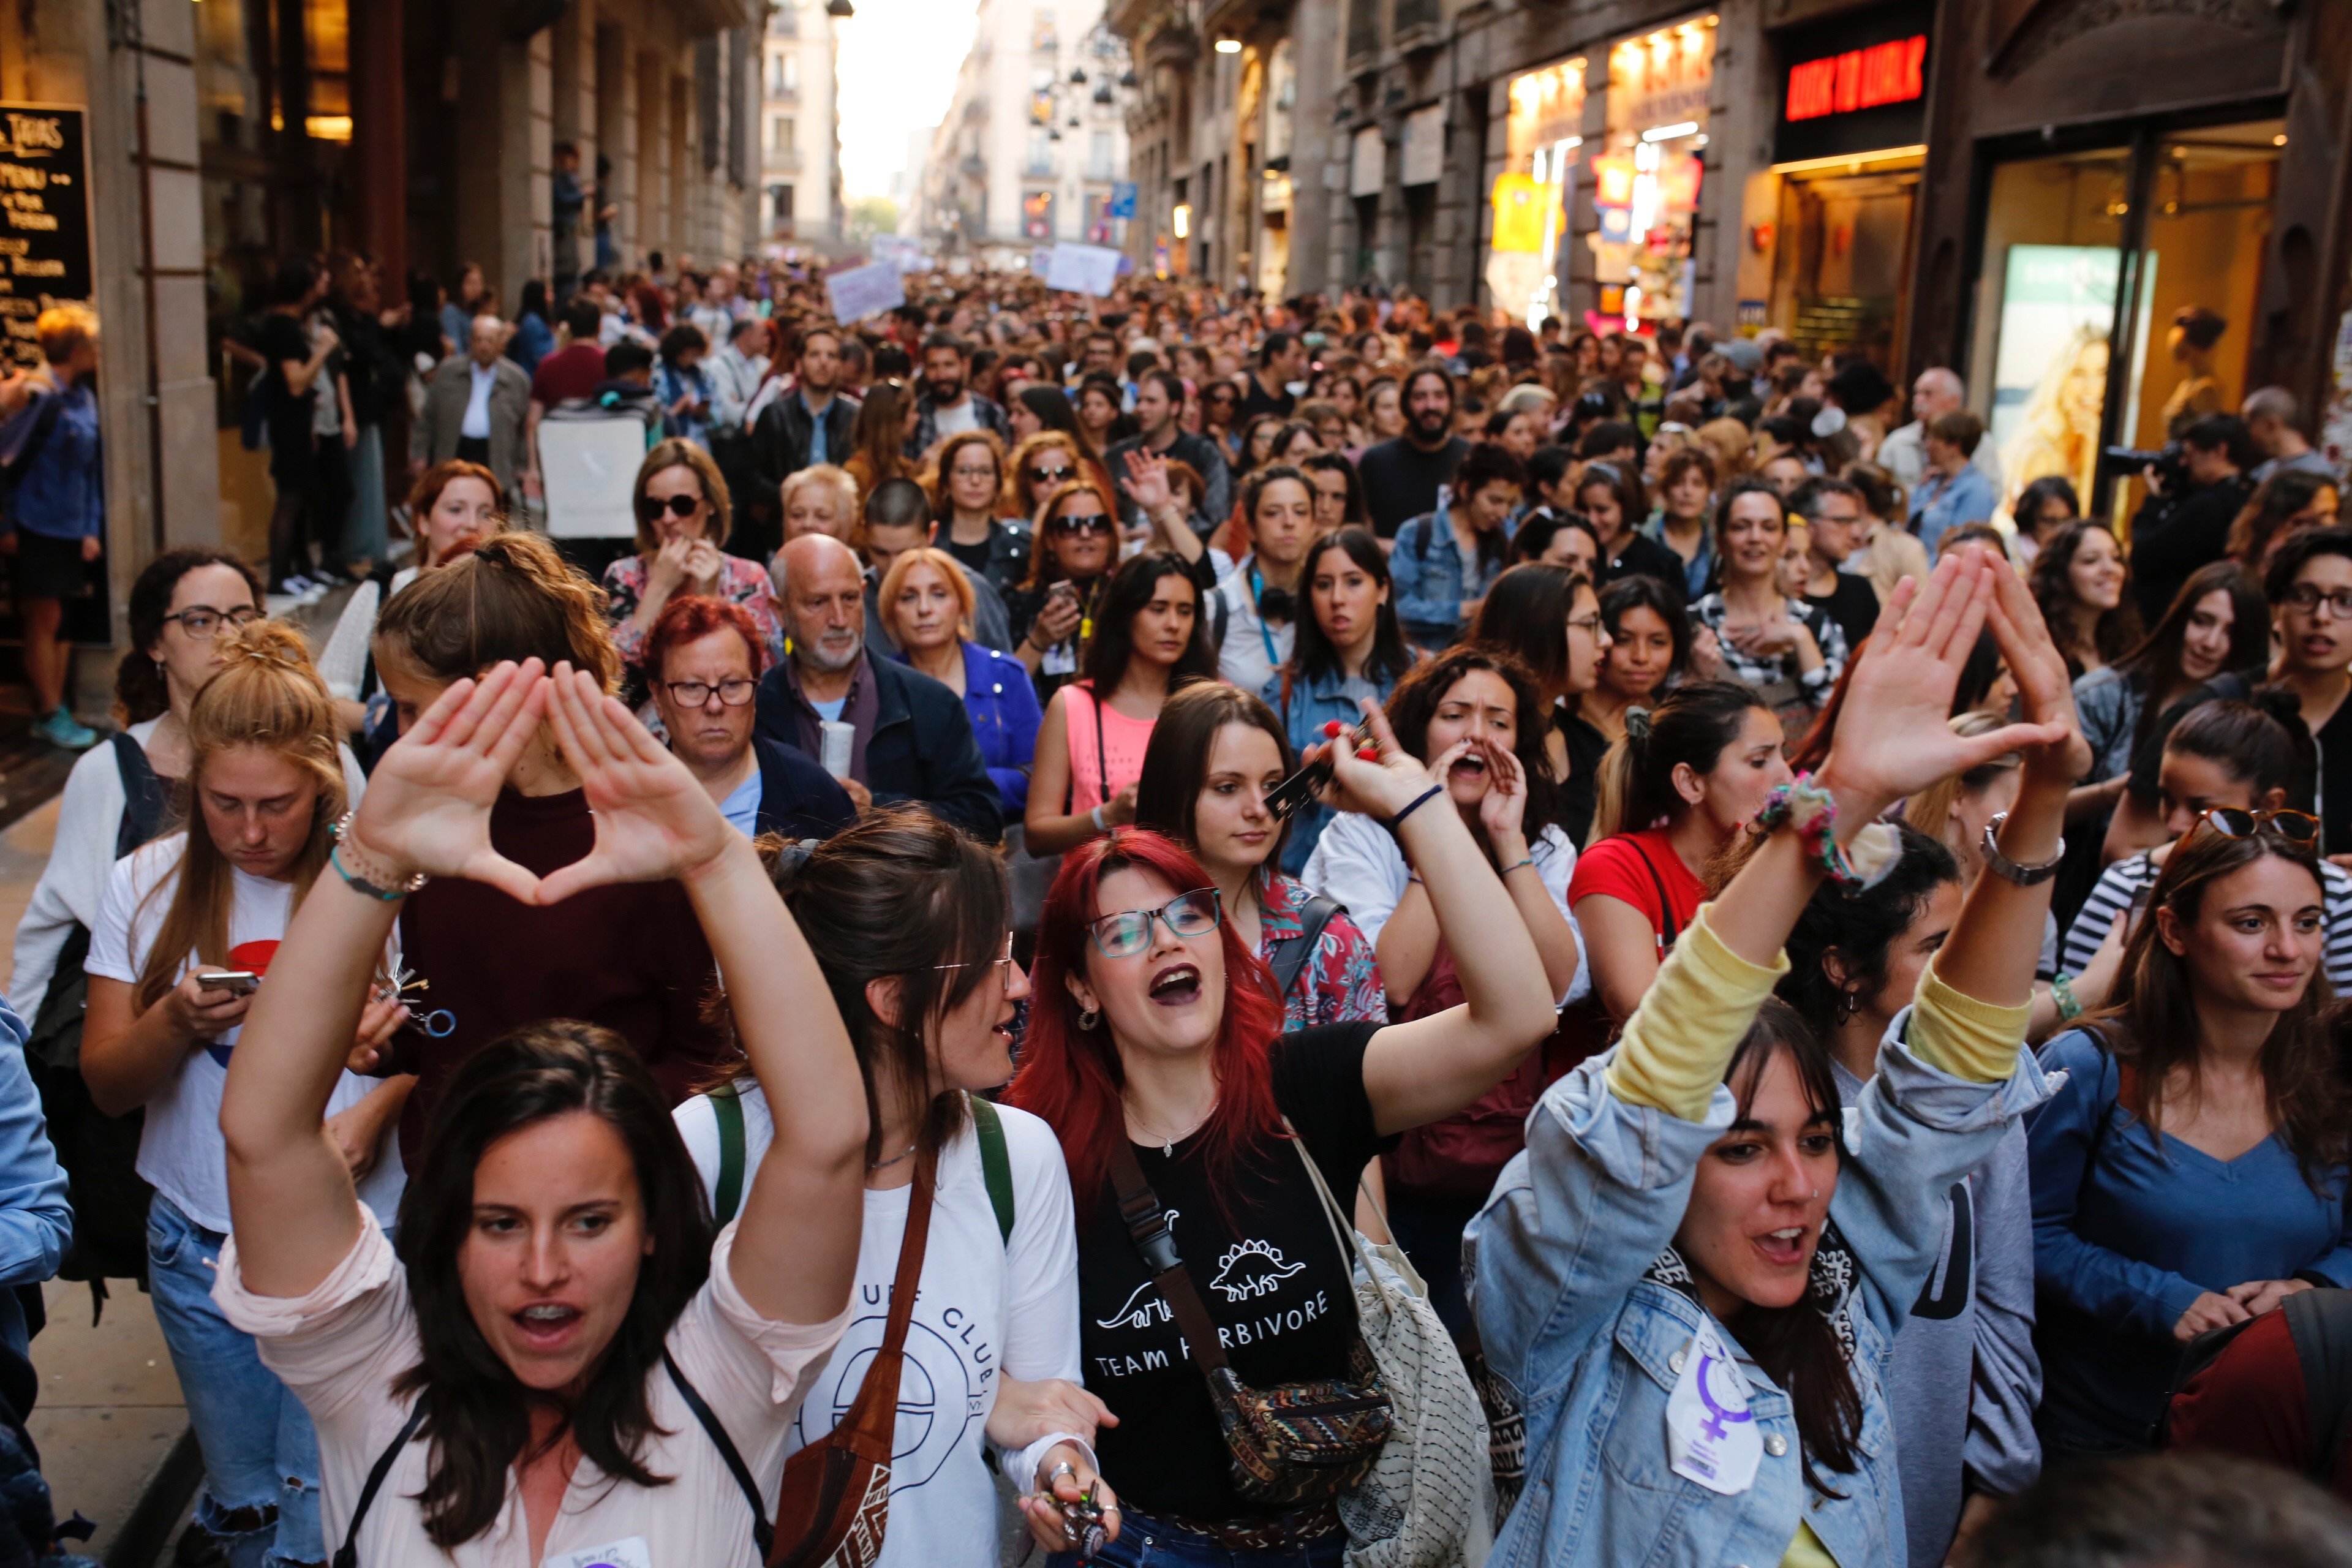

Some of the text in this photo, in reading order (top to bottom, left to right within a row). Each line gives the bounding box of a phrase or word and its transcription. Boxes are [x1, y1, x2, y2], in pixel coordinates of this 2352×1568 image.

[943, 1308, 993, 1383] CLUB
[1095, 1290, 1328, 1376] TEAM HRBIVORE
